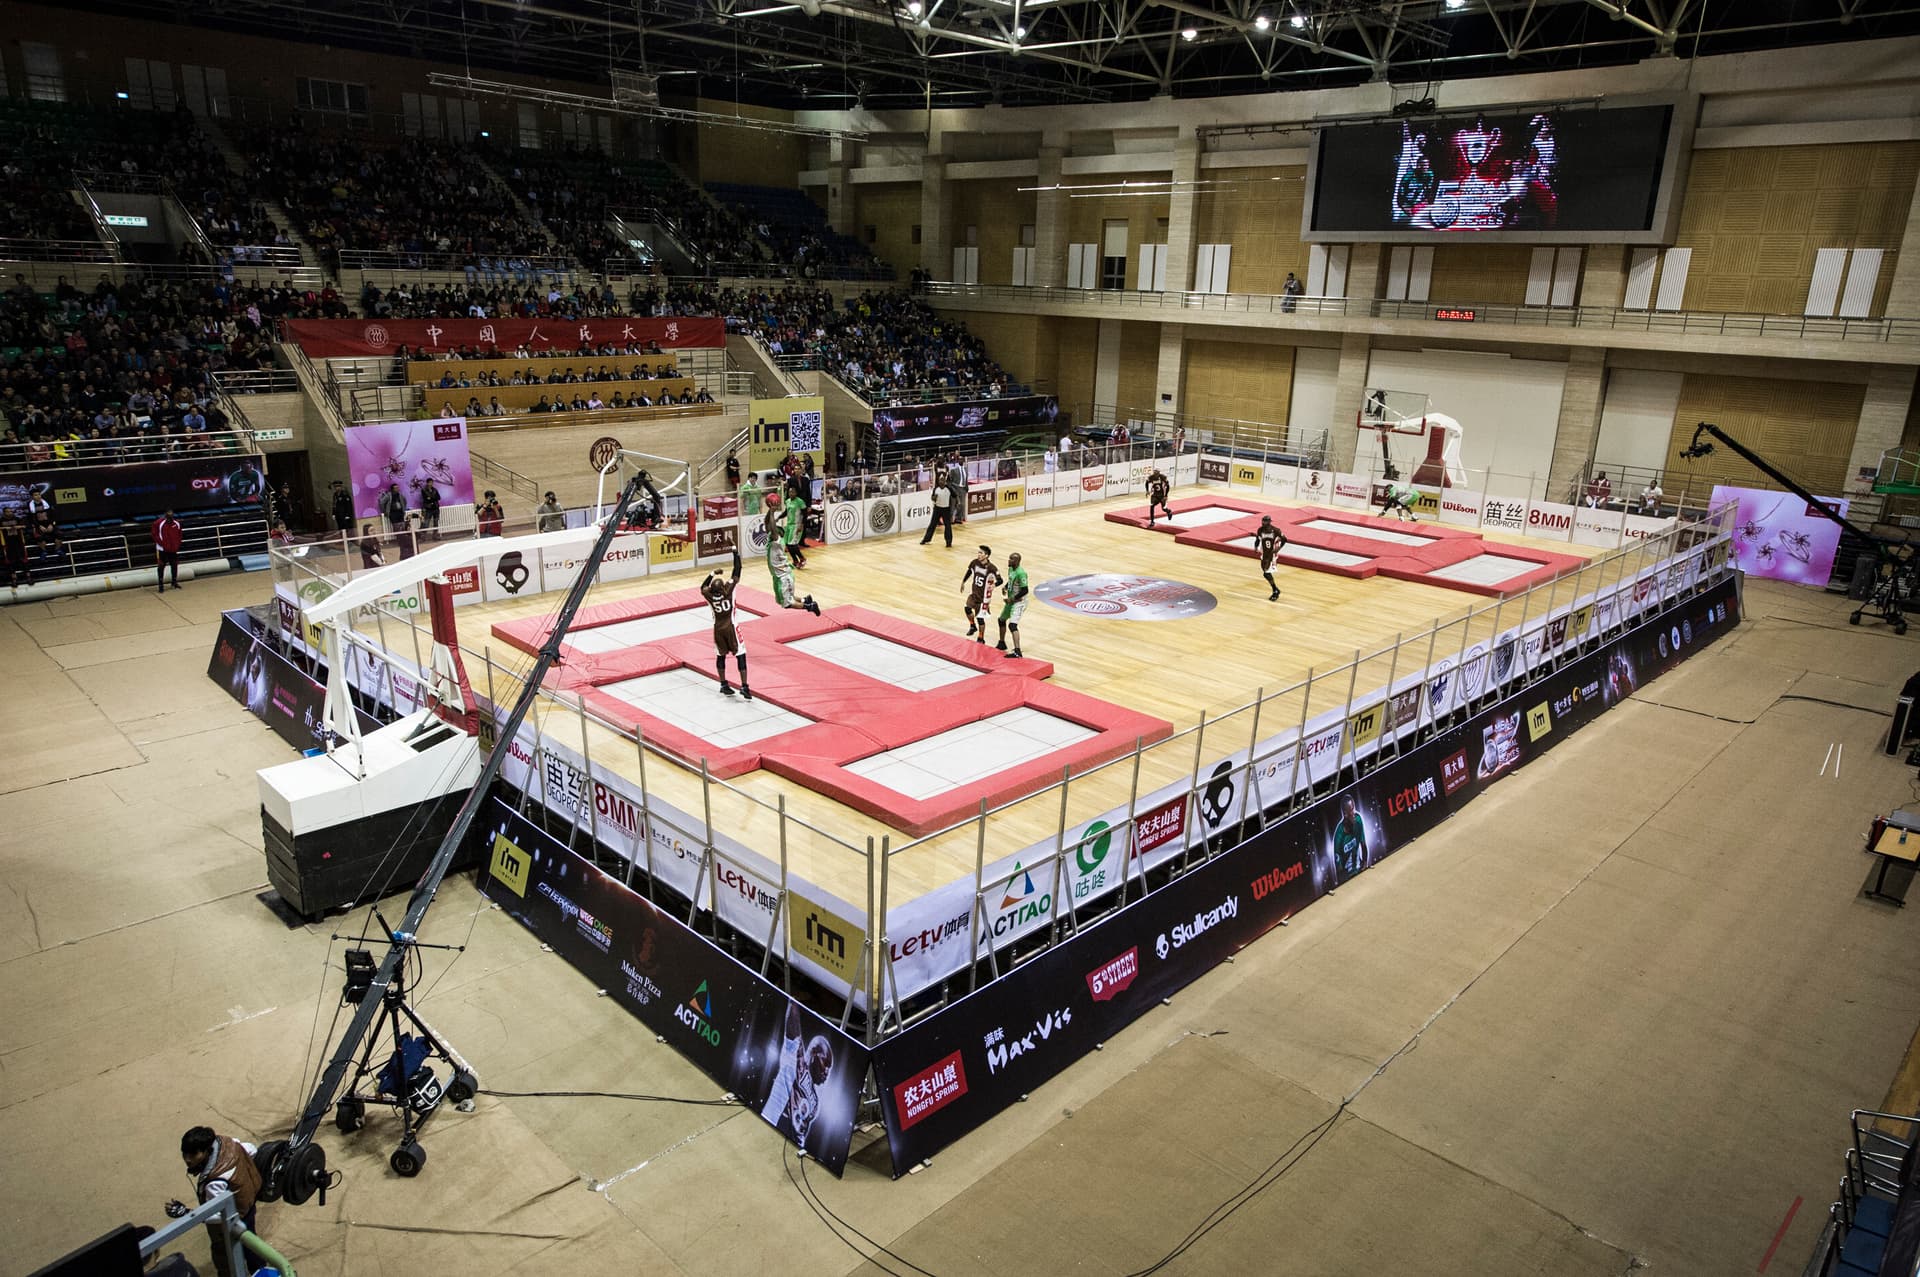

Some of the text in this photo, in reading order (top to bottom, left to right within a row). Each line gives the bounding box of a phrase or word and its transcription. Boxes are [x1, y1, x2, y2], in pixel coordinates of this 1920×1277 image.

[754, 418, 789, 444] i'm
[1239, 468, 1255, 480] i'm
[1004, 490, 1018, 502] i'm
[1442, 500, 1477, 515] Wilson
[1483, 518, 1522, 529] DEOPROCE
[1529, 509, 1571, 529] 8MM
[713, 599, 731, 613] 50
[1533, 712, 1545, 729] i'm
[1139, 806, 1181, 839] 农夫山泉
[500, 847, 520, 877] i'm
[1074, 869, 1107, 899] 咕咚
[1250, 861, 1304, 901] Wilson
[805, 912, 846, 960] i'm
[1172, 895, 1239, 948] Skullcandy
[620, 959, 644, 985] Muken
[643, 976, 662, 998] Pizza
[904, 1063, 957, 1109] 农夫山泉
[907, 1080, 959, 1120] NONGFU SPRING
